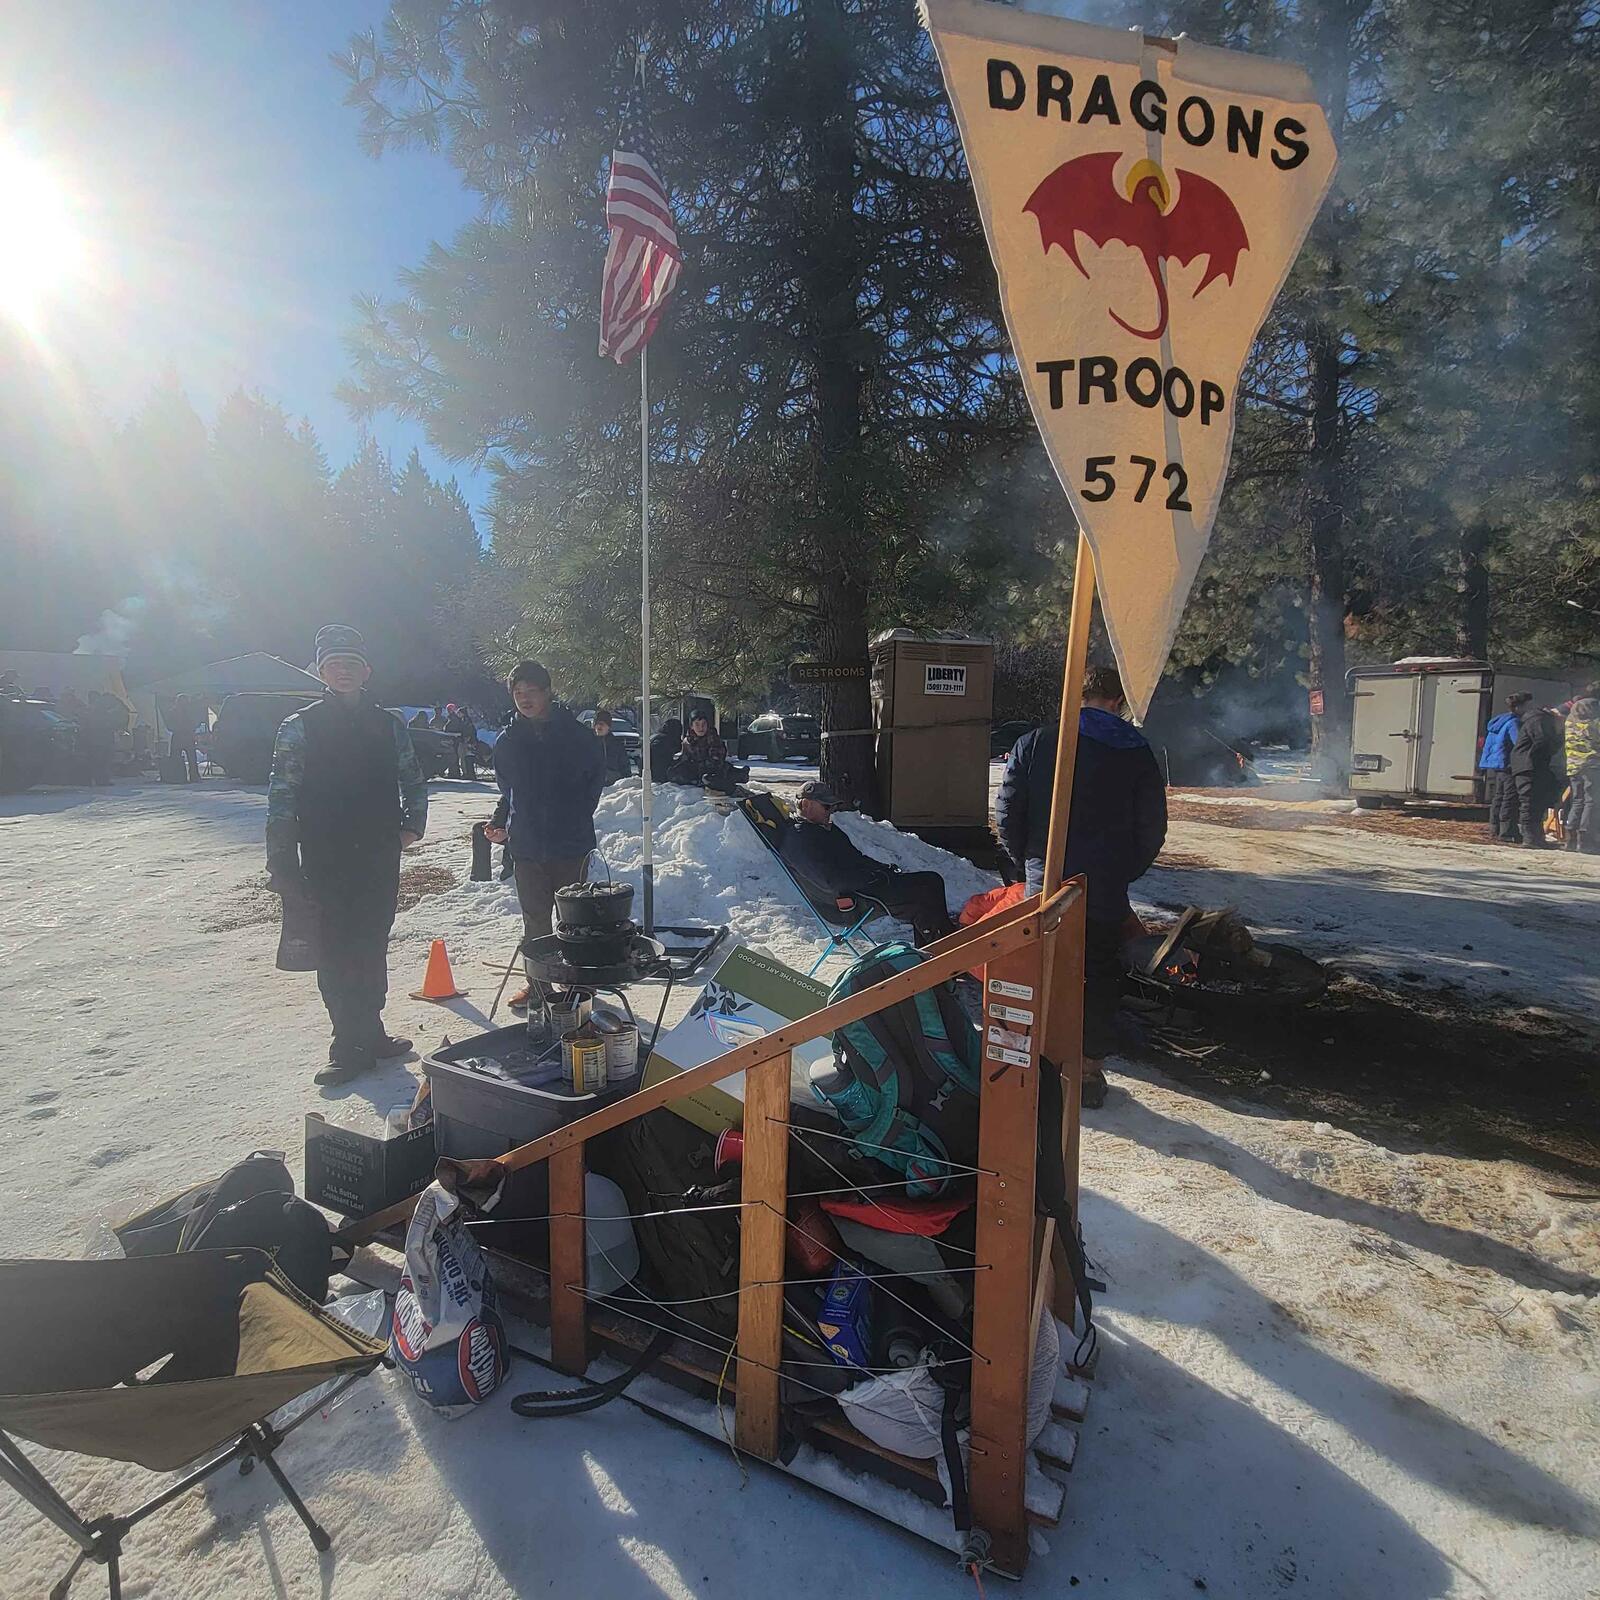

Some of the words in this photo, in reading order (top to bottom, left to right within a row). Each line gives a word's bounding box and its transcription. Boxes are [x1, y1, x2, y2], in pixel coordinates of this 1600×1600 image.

[986, 58, 1310, 171] DRAGONS
[1036, 355, 1226, 426] TROOP
[1080, 455, 1192, 512] 572
[800, 666, 865, 678] RESTROOMS
[927, 667, 965, 683] LIBERTY
[737, 953, 756, 965] FOOD
[766, 966, 779, 975] ART
[779, 972, 793, 982] THE
[796, 981, 815, 993] FOOD
[407, 1130, 423, 1142] ALL
[326, 1183, 338, 1195] ALL
[453, 1277, 471, 1307] THE
[468, 1325, 496, 1397] KINGSFORD
